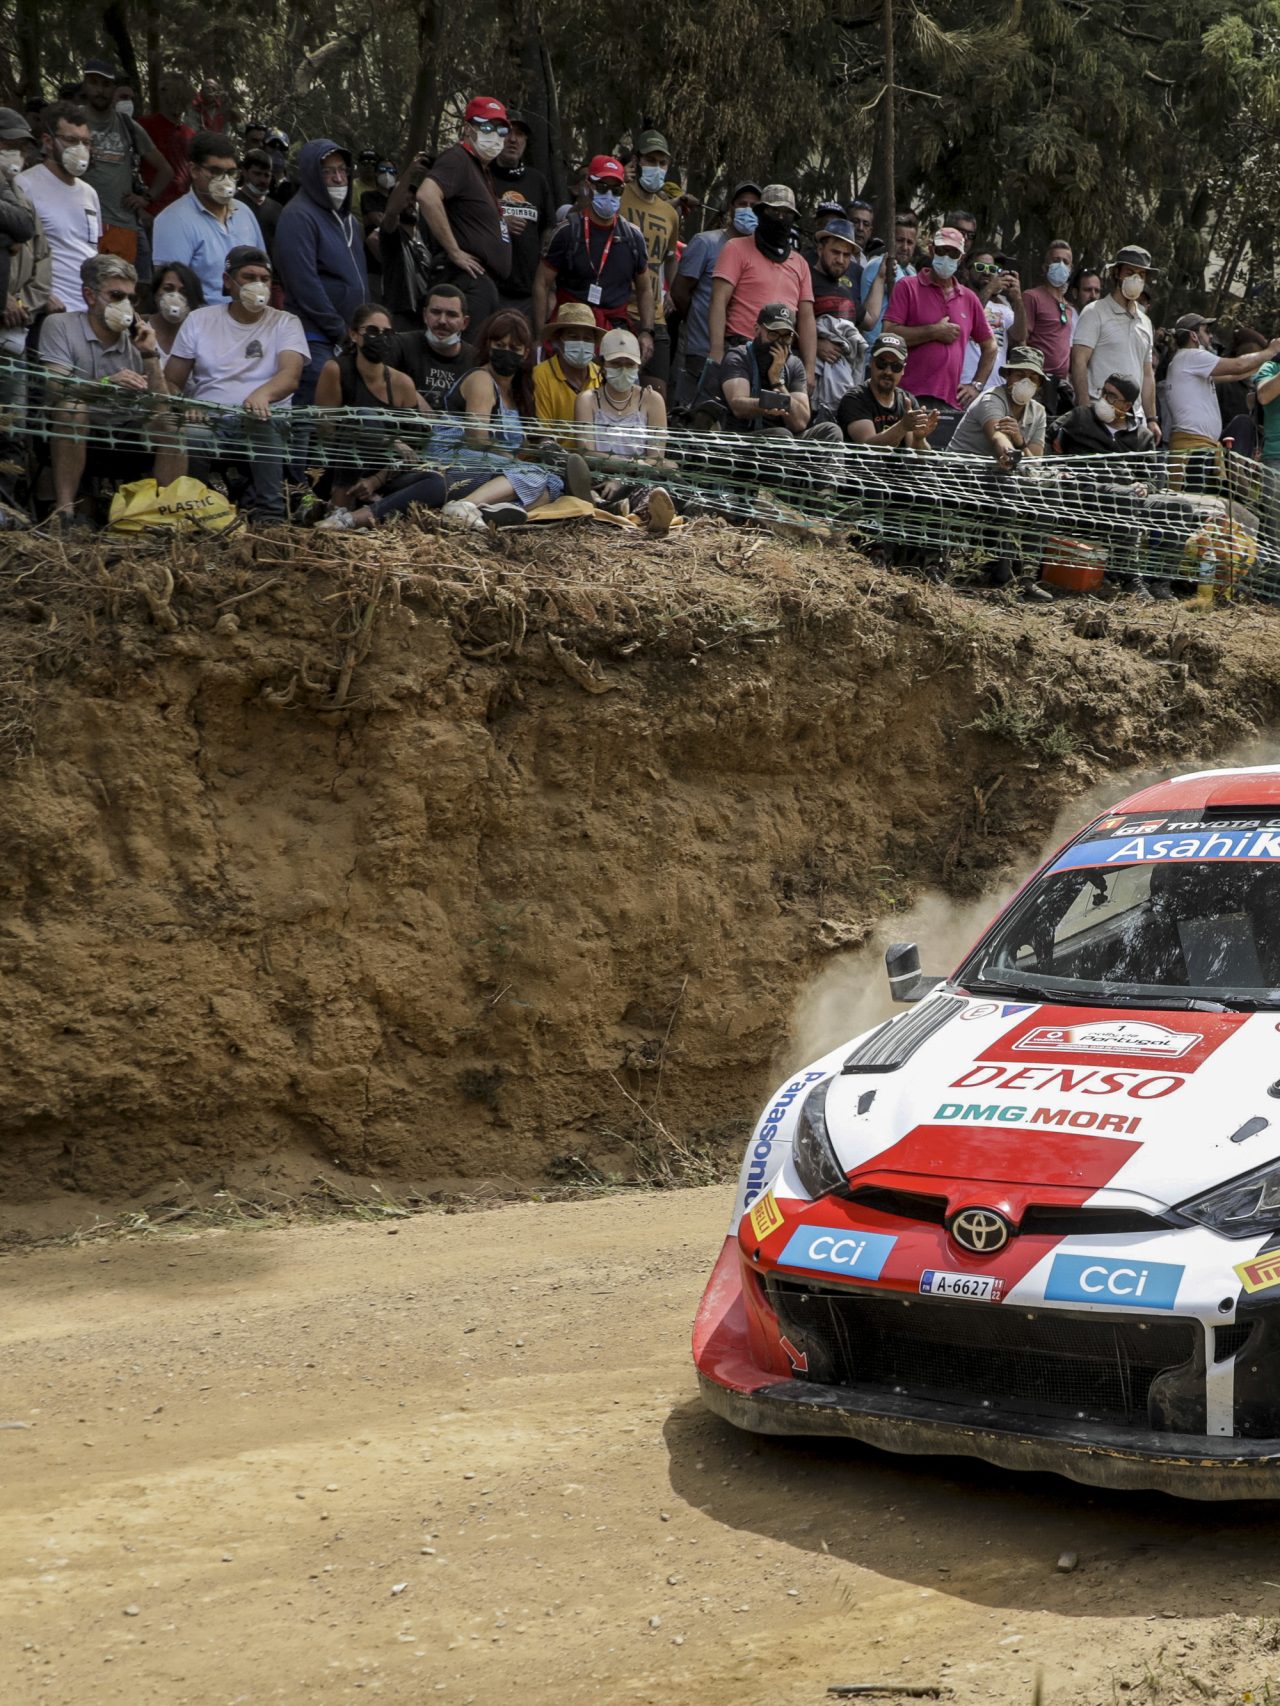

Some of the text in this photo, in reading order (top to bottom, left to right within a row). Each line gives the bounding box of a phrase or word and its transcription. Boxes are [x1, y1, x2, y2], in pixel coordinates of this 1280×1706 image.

[430, 367, 456, 382] PINK
[425, 376, 453, 390] FLOY
[158, 495, 214, 516] PLASTIC
[1167, 819, 1261, 832] TOYOTA
[1079, 1035, 1172, 1047] Portugal
[948, 1065, 1186, 1100] DENSO
[937, 1276, 989, 1297] A-6627
